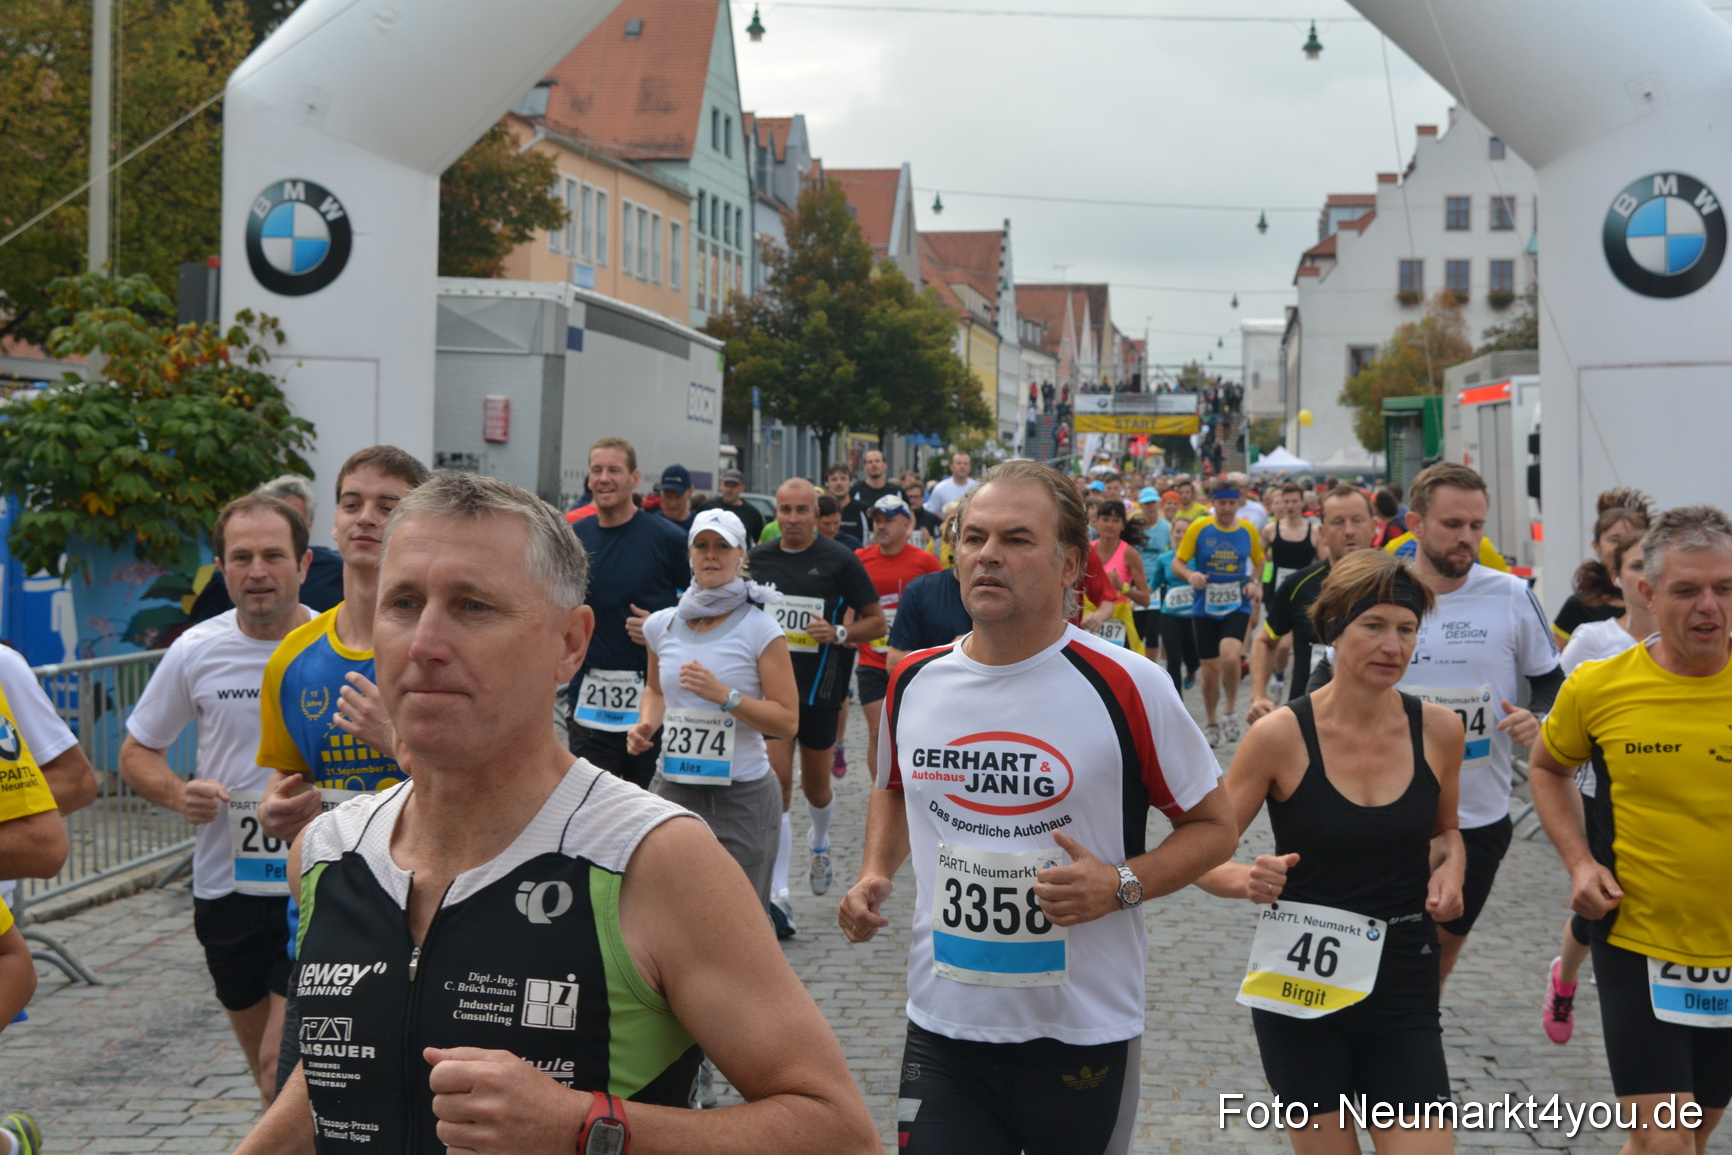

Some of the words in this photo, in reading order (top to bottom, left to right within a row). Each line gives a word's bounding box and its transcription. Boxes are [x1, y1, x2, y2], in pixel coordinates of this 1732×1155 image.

[253, 181, 345, 222] BMW
[1612, 174, 1719, 217] BMW
[1115, 418, 1157, 430] START
[1441, 621, 1471, 630] HECK
[1445, 629, 1488, 639] DESIGN
[586, 684, 637, 708] 2132
[684, 716, 722, 725] Neumarkt
[667, 726, 726, 756] 2374
[1625, 742, 1682, 754] Dieter
[679, 761, 702, 773] Alex
[912, 748, 1038, 772] GERHART
[1040, 761, 1052, 772] &
[911, 770, 966, 782] Autohaus
[965, 773, 1055, 797] JÄNIG
[929, 800, 951, 822] Das
[951, 817, 1010, 838] sportliche
[1013, 814, 1072, 838] Autohaus
[939, 854, 971, 874] PARTL
[972, 863, 1037, 878] Neumarkt
[943, 878, 1053, 935] 3358
[1262, 910, 1300, 924] PARTL
[1303, 915, 1362, 937] Neumarkt
[1286, 932, 1340, 977] 46
[444, 981, 455, 991] C.
[457, 982, 517, 997] Brückmann
[468, 972, 518, 987] Dipl.-Ing.
[1281, 981, 1327, 1006] Birgit
[1684, 993, 1729, 1011] Dieter
[458, 999, 515, 1013] Industrial
[452, 1010, 513, 1026] Consulting
